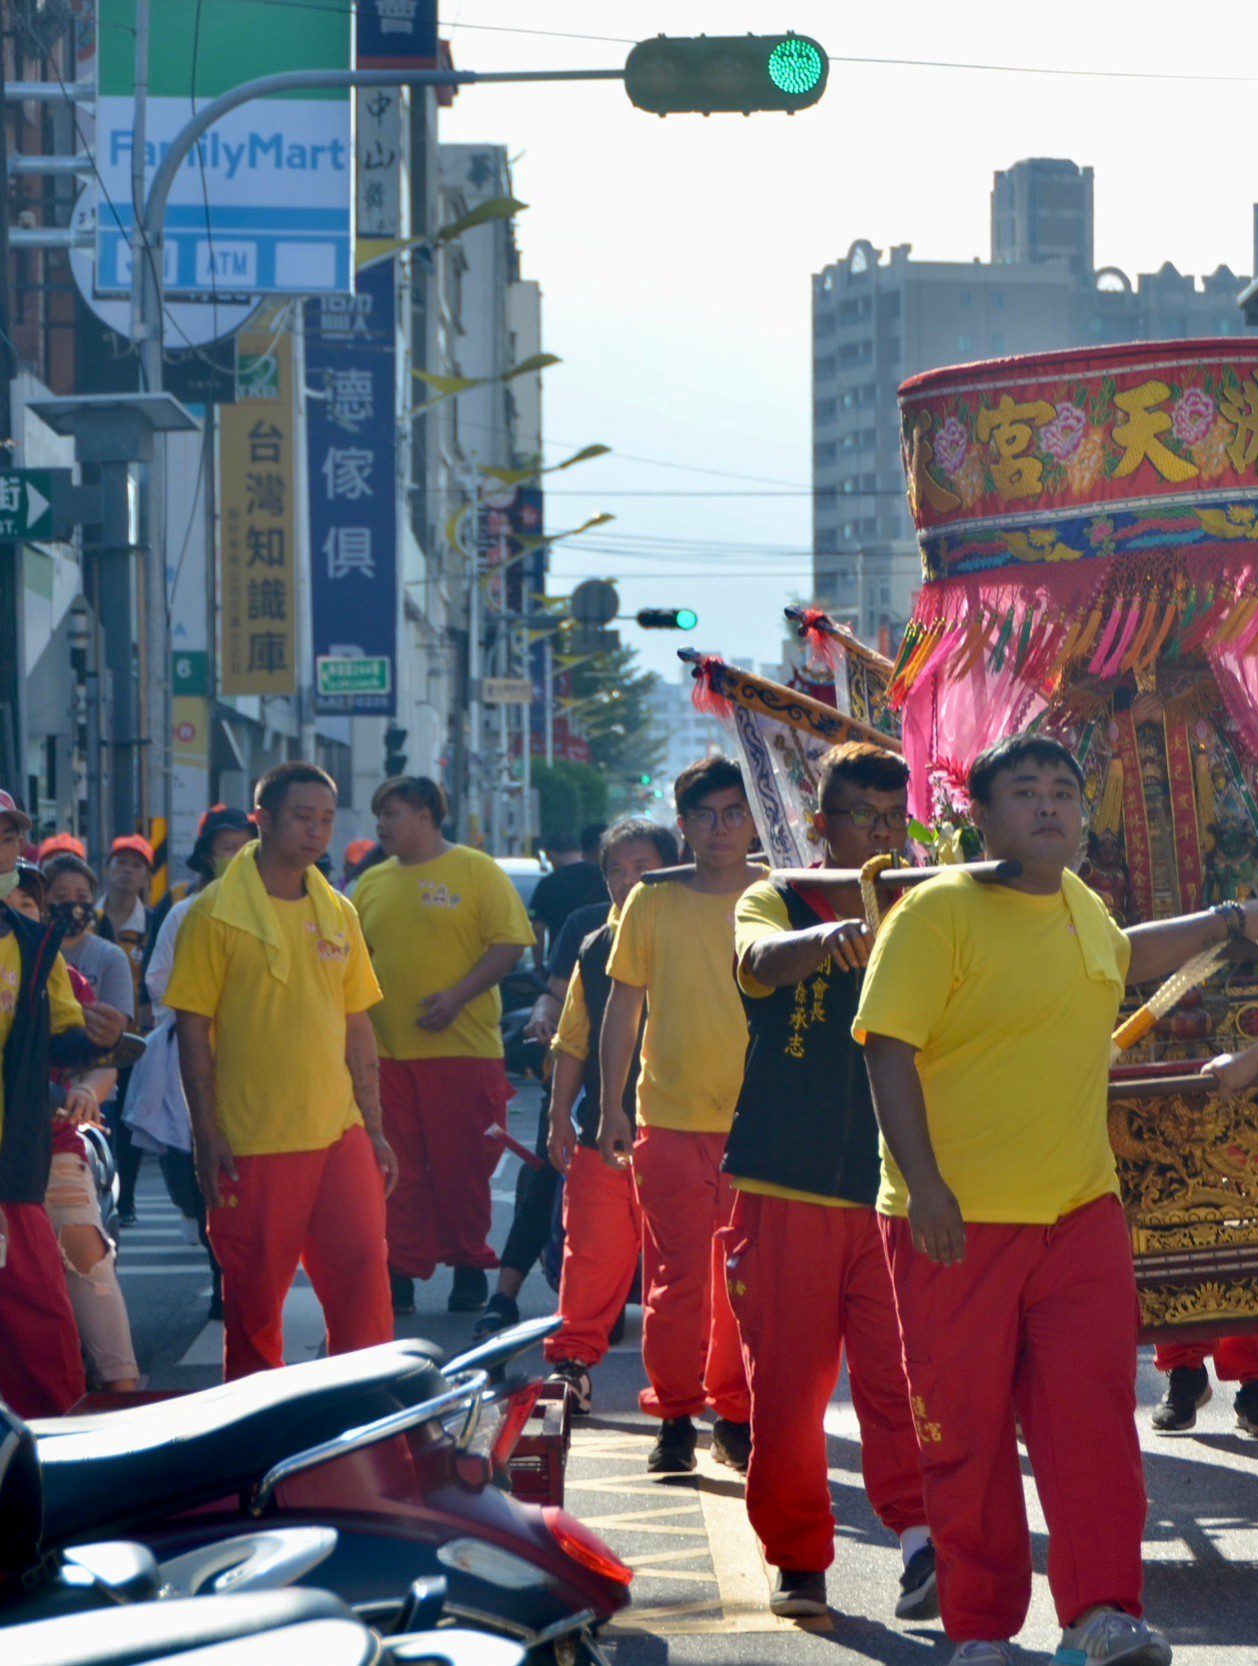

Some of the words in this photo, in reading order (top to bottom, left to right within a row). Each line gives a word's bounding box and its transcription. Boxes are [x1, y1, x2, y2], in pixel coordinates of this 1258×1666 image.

[207, 251, 248, 276] ATM
[246, 420, 288, 676] 台灣知識庫
